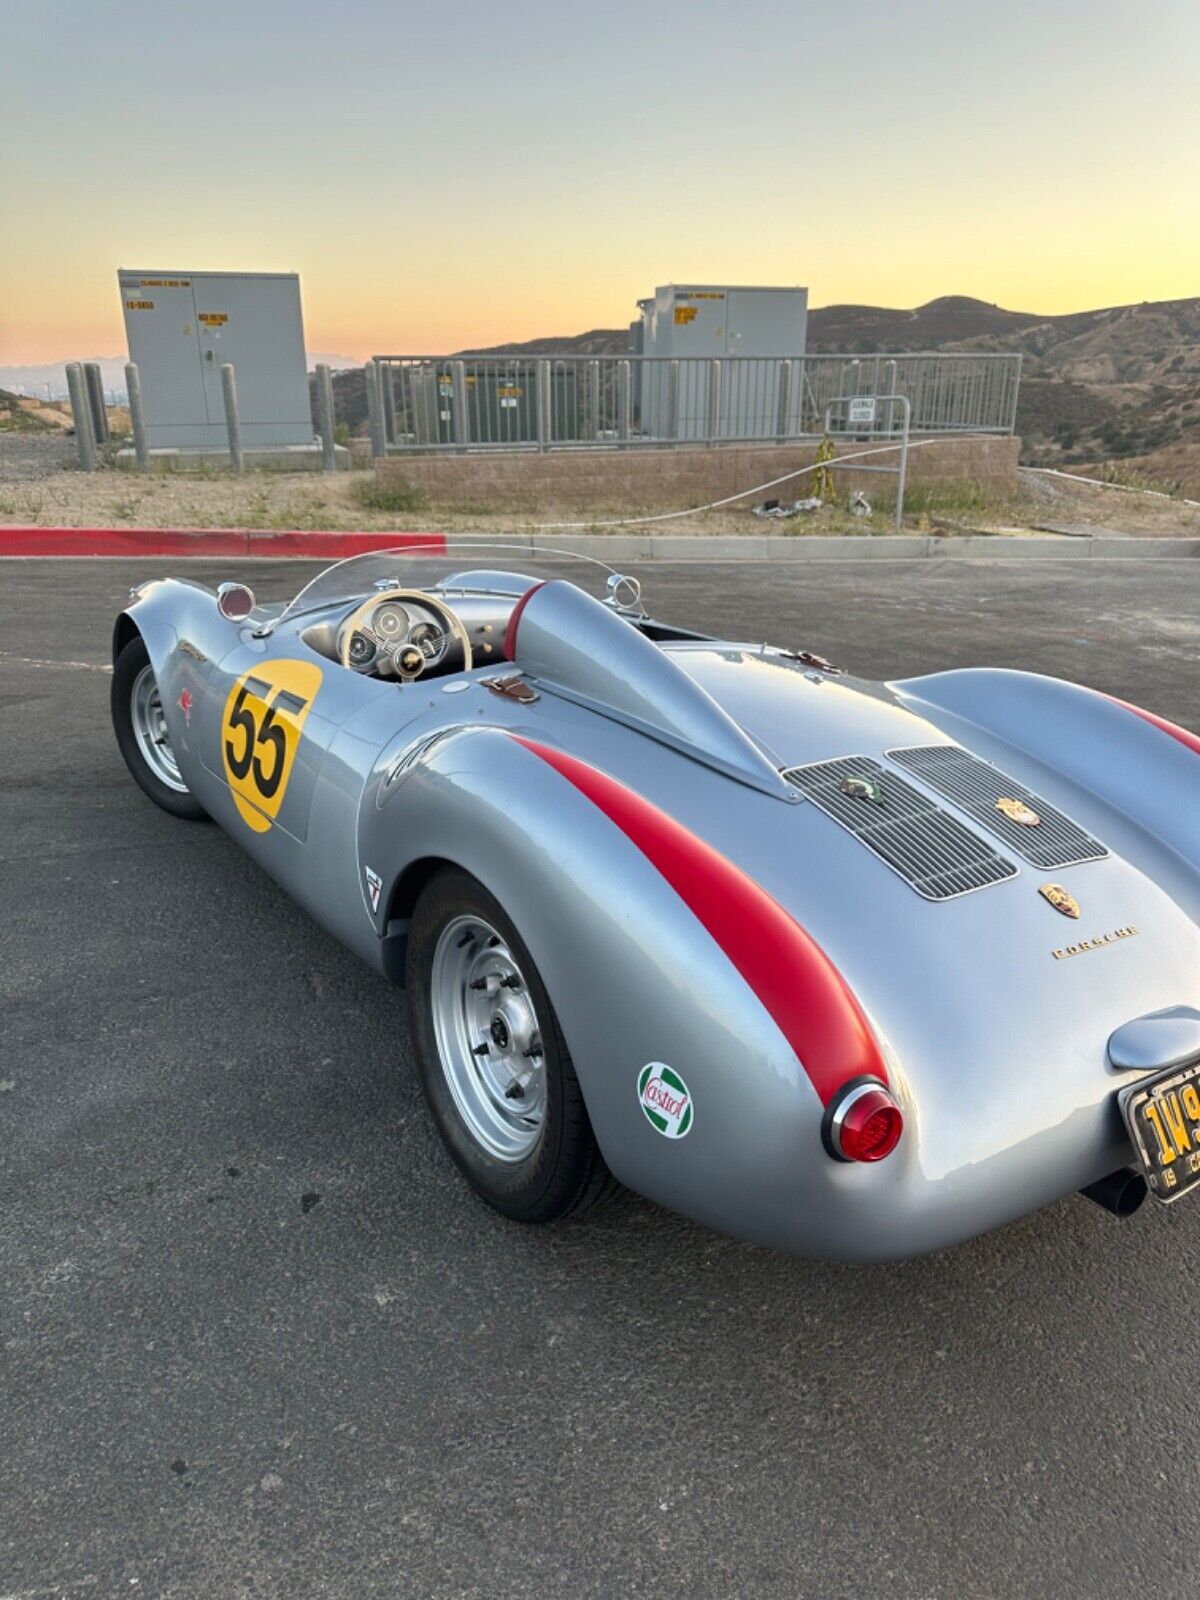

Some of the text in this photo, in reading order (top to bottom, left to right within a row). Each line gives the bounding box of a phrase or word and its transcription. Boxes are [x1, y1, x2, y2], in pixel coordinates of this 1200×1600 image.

[226, 676, 308, 799] 55
[1052, 926, 1137, 960] PORSCHE
[645, 1077, 688, 1119] Castrol
